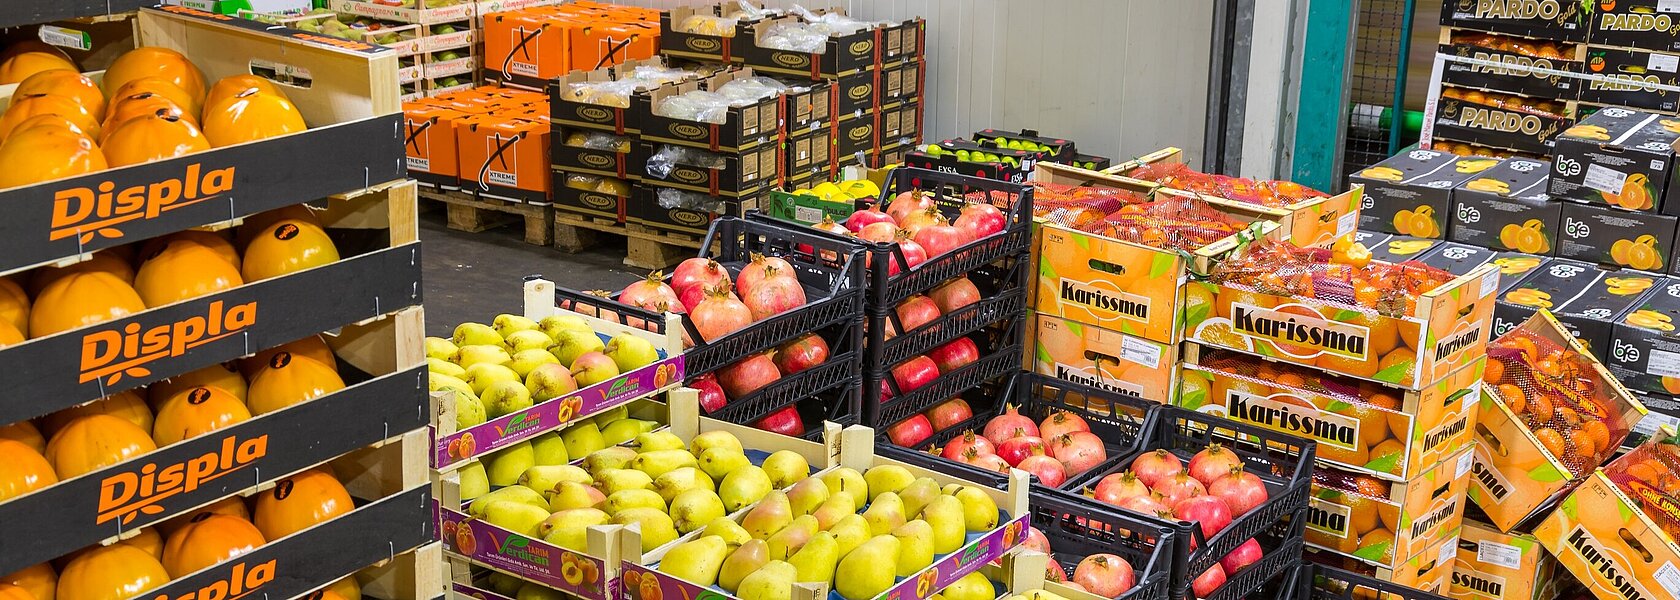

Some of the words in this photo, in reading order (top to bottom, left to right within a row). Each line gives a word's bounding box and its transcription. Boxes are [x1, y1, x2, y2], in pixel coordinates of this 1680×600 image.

[1475, 0, 1560, 20] PARDO
[1557, 2, 1577, 26] Gold
[1600, 13, 1672, 32] PARDO
[513, 61, 537, 71] XTREME
[1471, 52, 1553, 79] PARDO
[1590, 73, 1661, 92] PARDO
[1459, 107, 1542, 136] PARDO
[1537, 121, 1558, 143] Gold
[490, 171, 516, 181] XTREME
[51, 163, 235, 228] Displa
[678, 212, 698, 220] NERO
[1061, 281, 1148, 319] Karissma
[80, 300, 257, 372] Displa
[1234, 306, 1365, 355] Karissma
[1435, 326, 1480, 363] Karissma
[1229, 394, 1356, 445] Karissma
[1424, 415, 1467, 453] Karissma
[98, 434, 268, 513] Displa
[1412, 501, 1456, 540] Karissma
[527, 544, 549, 558] TARIM
[1568, 528, 1646, 600] Karissm
